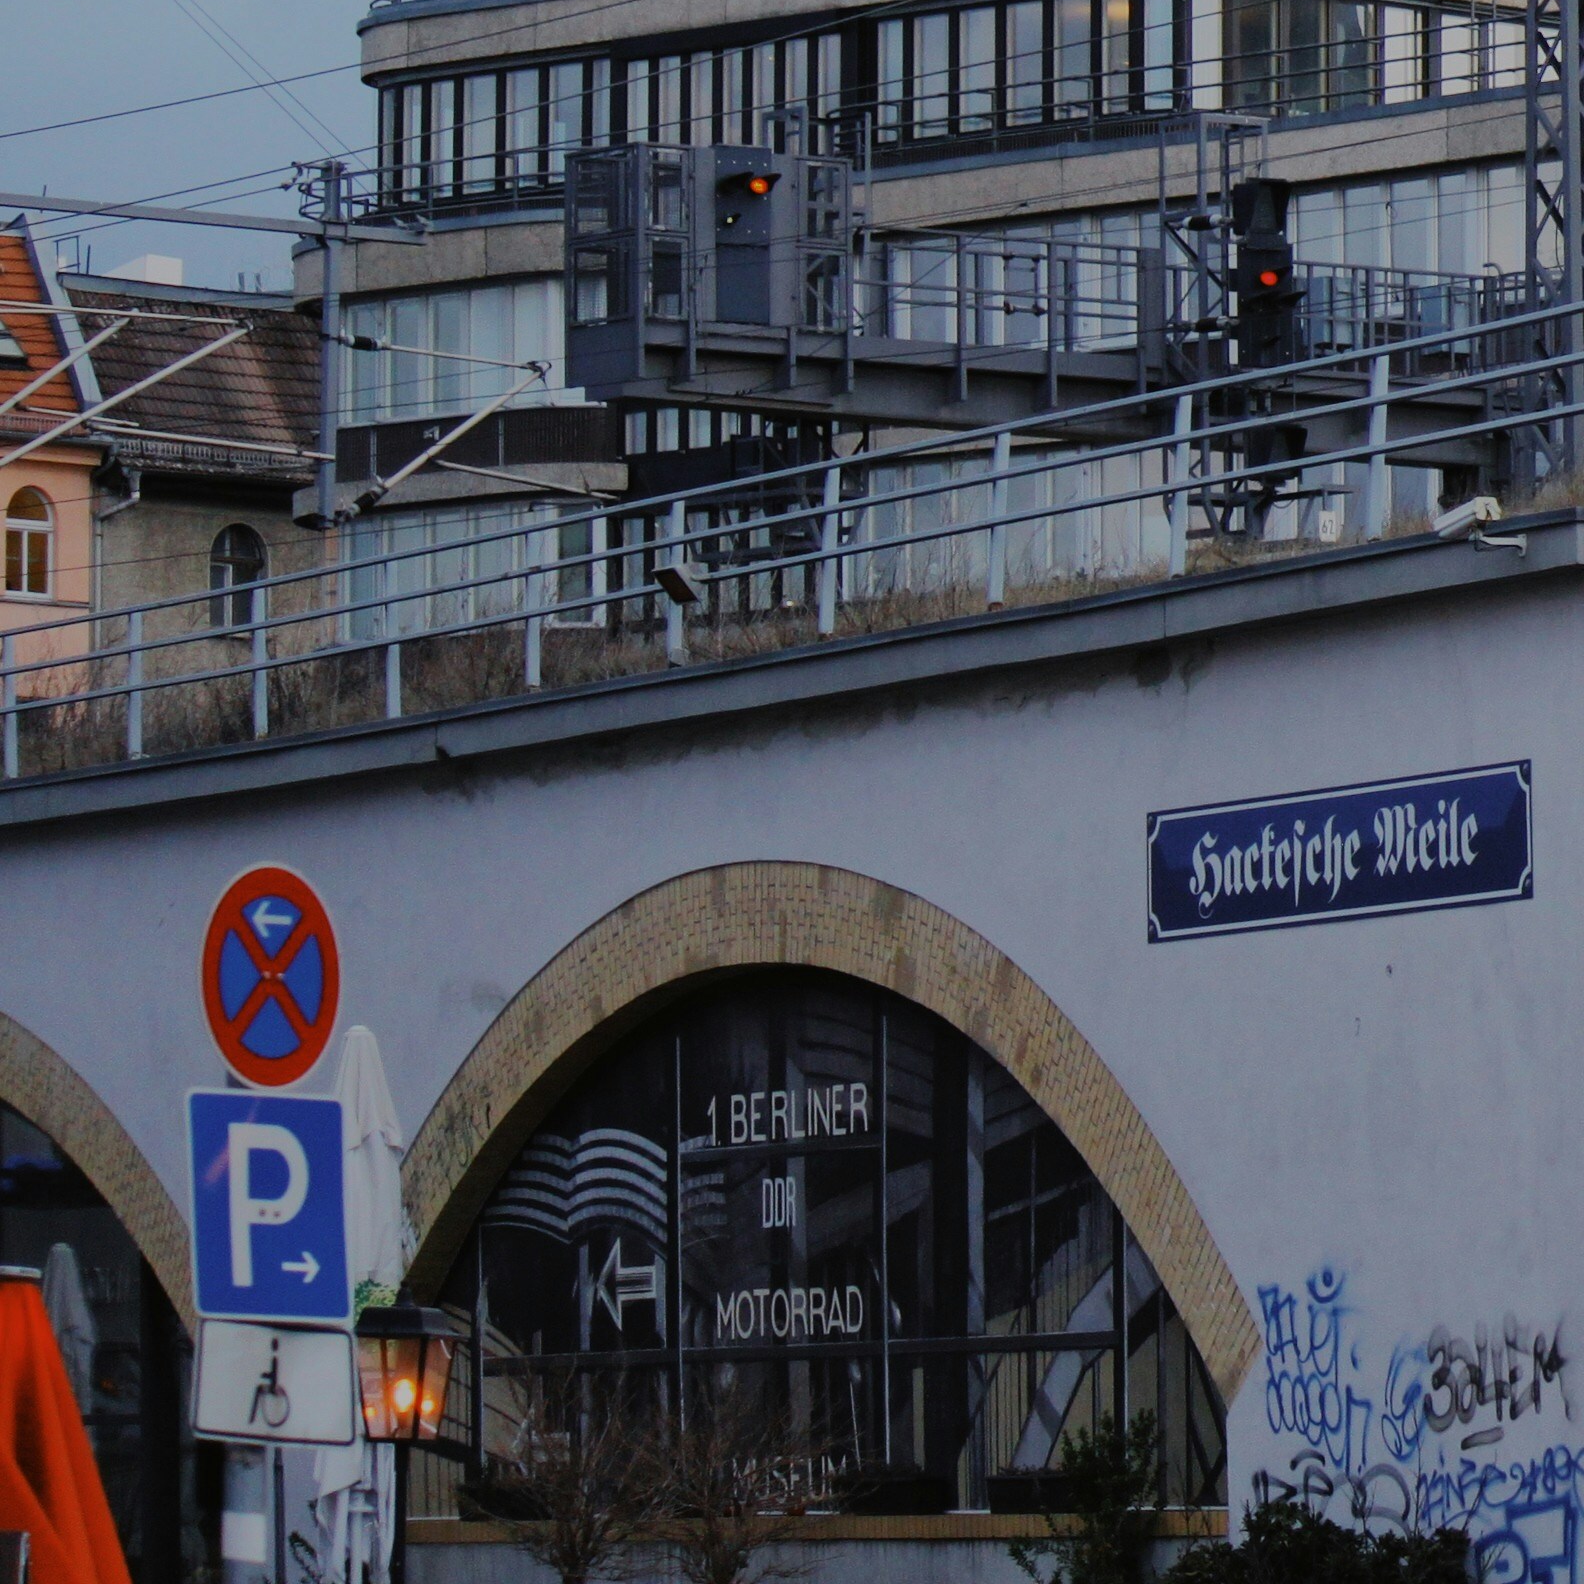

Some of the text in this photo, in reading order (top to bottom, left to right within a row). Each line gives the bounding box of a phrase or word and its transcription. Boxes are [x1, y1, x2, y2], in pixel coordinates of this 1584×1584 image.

[1373, 797, 1478, 877] Meile
[731, 1082, 868, 1144] BERLINER
[228, 1122, 310, 1287] P
[762, 1176, 796, 1229] DDR
[717, 1285, 864, 1340] MOTORRAD
